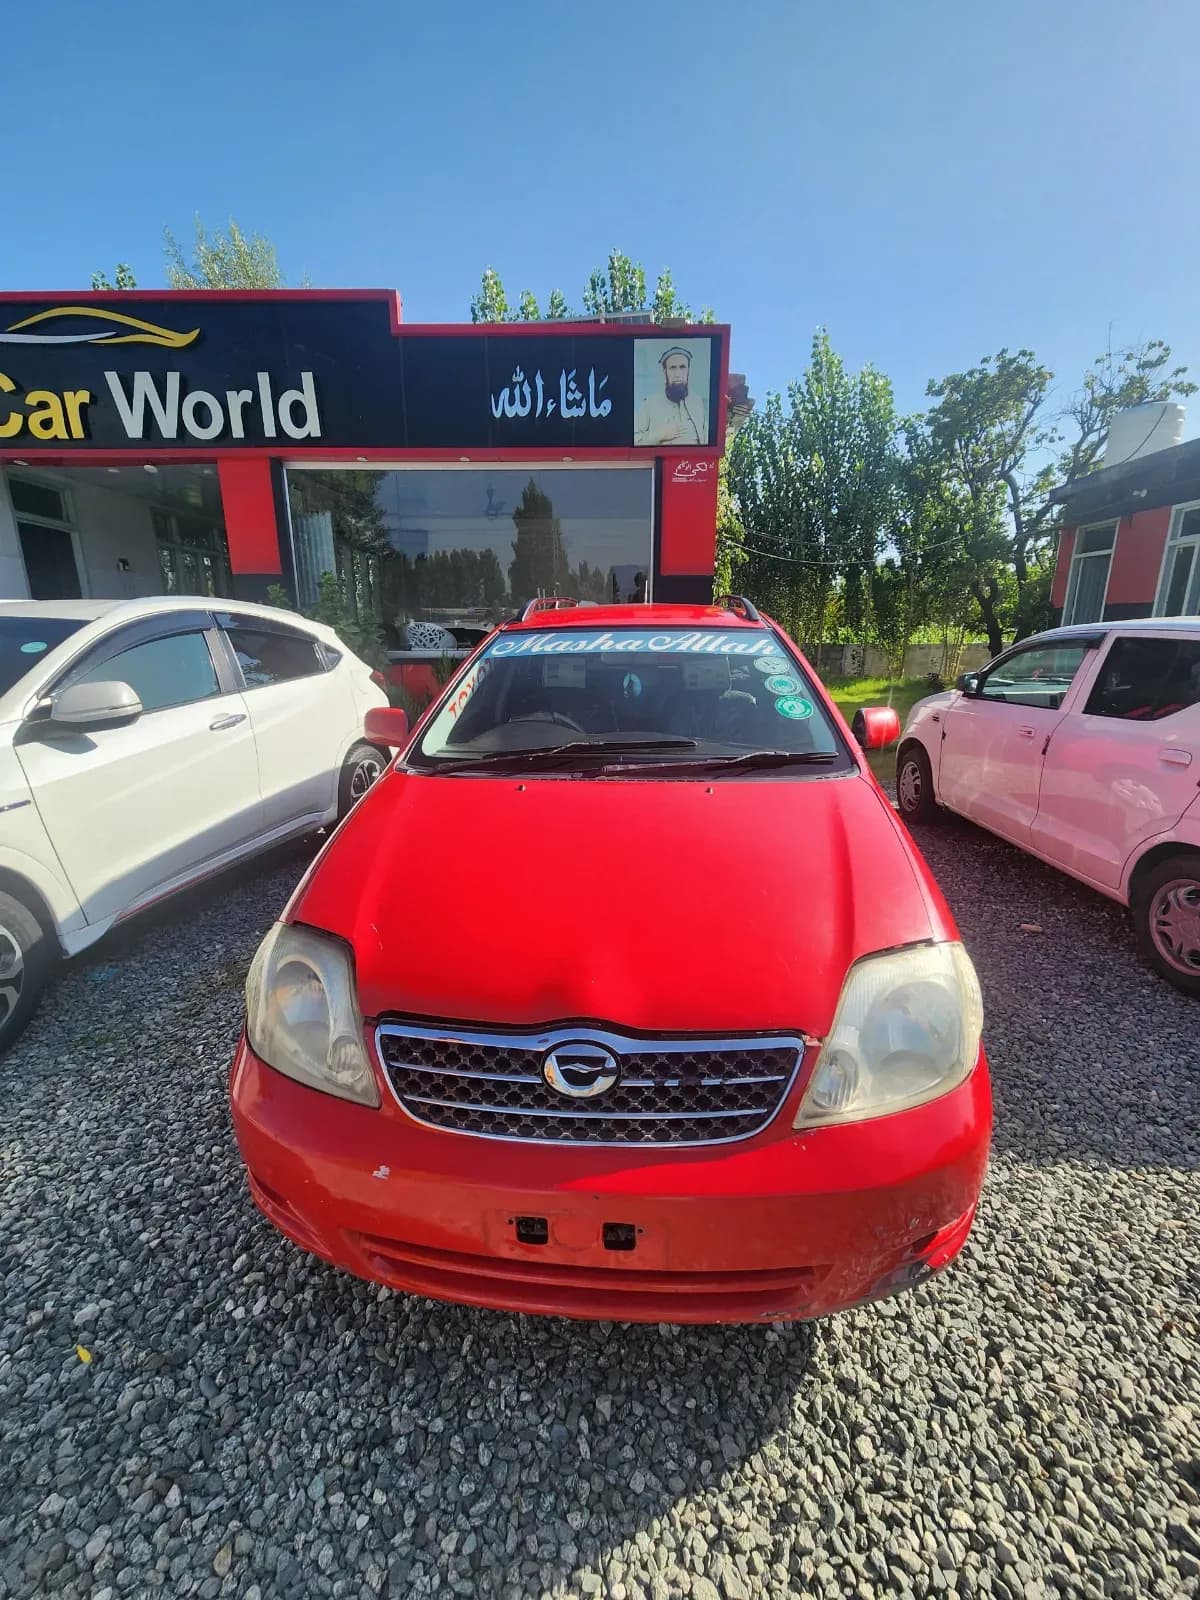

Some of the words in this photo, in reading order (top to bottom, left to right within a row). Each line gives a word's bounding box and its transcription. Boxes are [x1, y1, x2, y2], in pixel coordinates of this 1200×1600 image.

[104, 371, 322, 440] World
[491, 632, 646, 656] Masha
[648, 631, 777, 655] Allah
